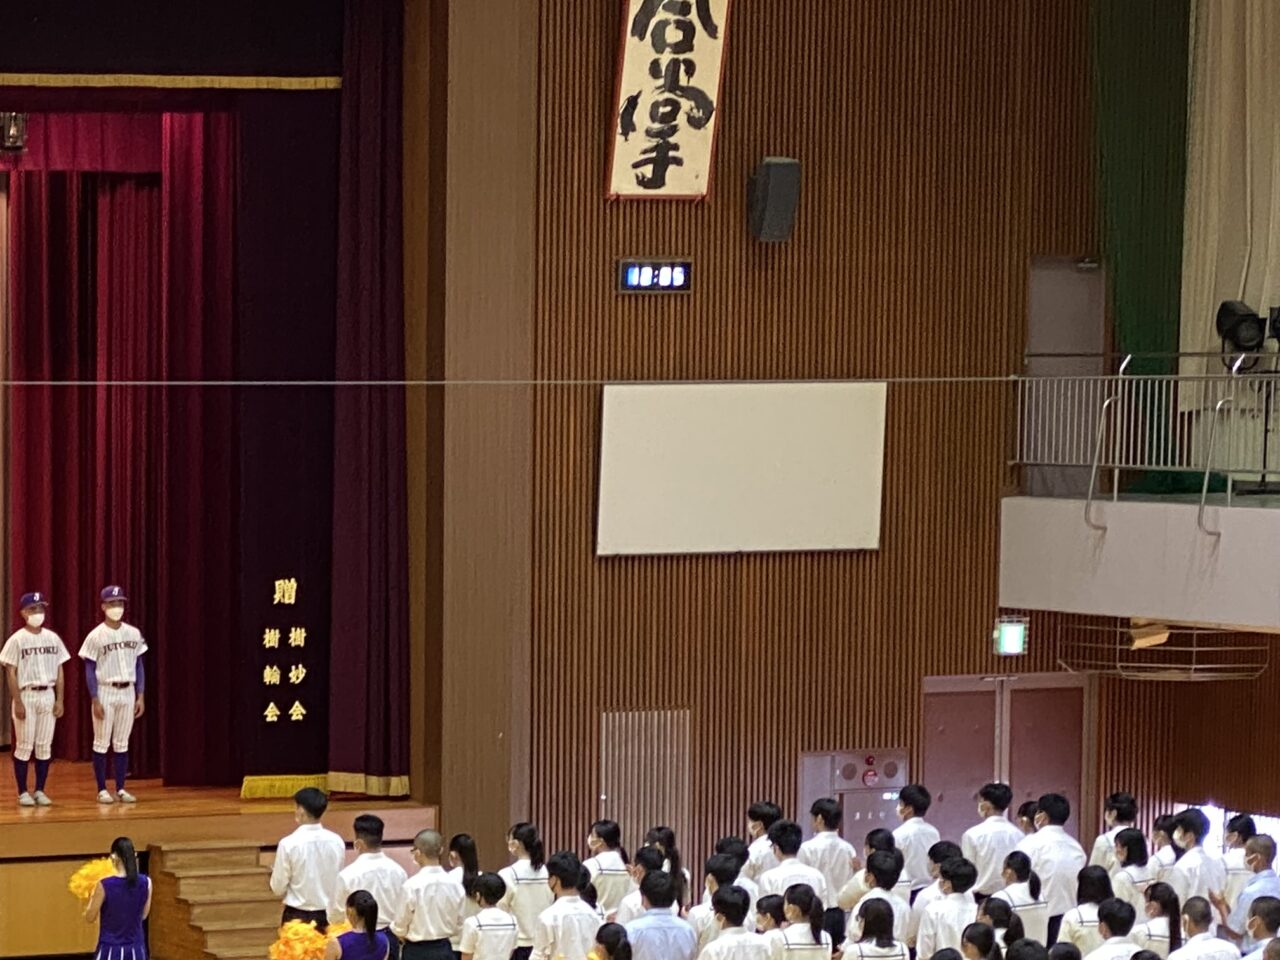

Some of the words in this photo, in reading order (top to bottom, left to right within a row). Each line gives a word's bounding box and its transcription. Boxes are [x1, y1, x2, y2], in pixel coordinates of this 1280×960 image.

[273, 578, 297, 604] 贈
[21, 646, 58, 659] JUTOKU
[102, 641, 138, 655] JUTOKU
